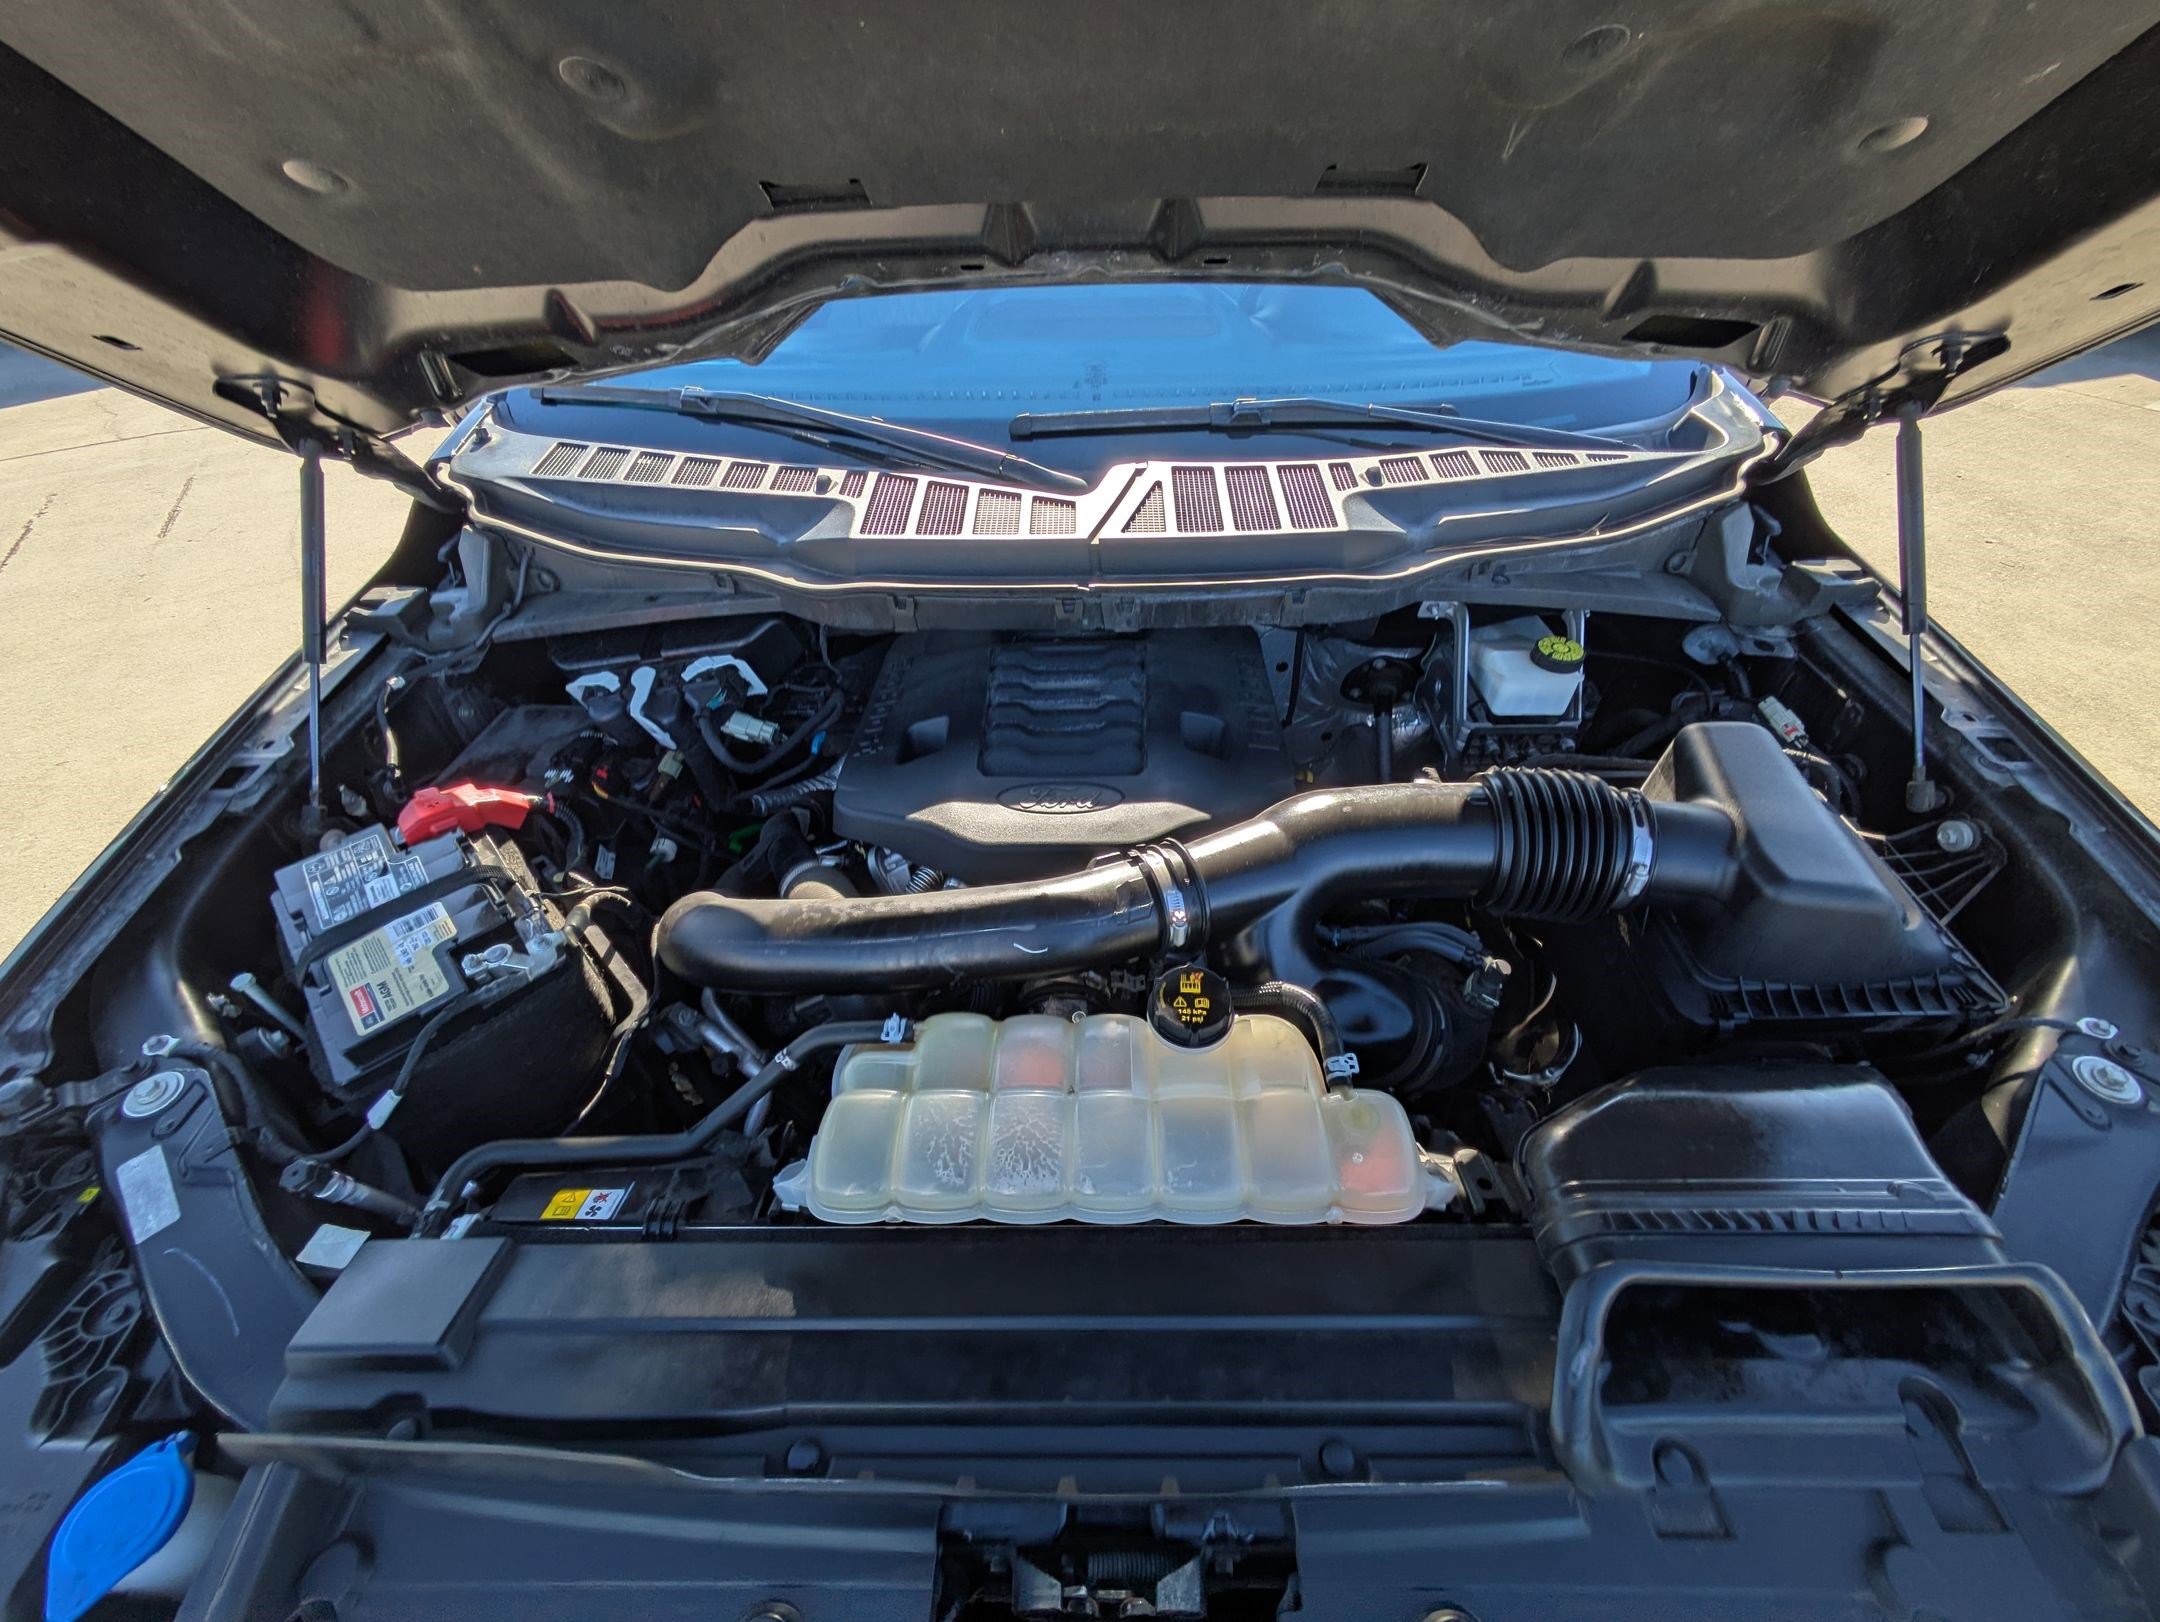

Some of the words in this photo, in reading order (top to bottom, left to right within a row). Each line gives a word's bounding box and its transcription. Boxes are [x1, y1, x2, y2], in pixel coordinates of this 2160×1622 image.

[1019, 785, 1102, 809] Ford
[1192, 1008, 1207, 1016] kPa
[1192, 1015, 1204, 1024] psi
